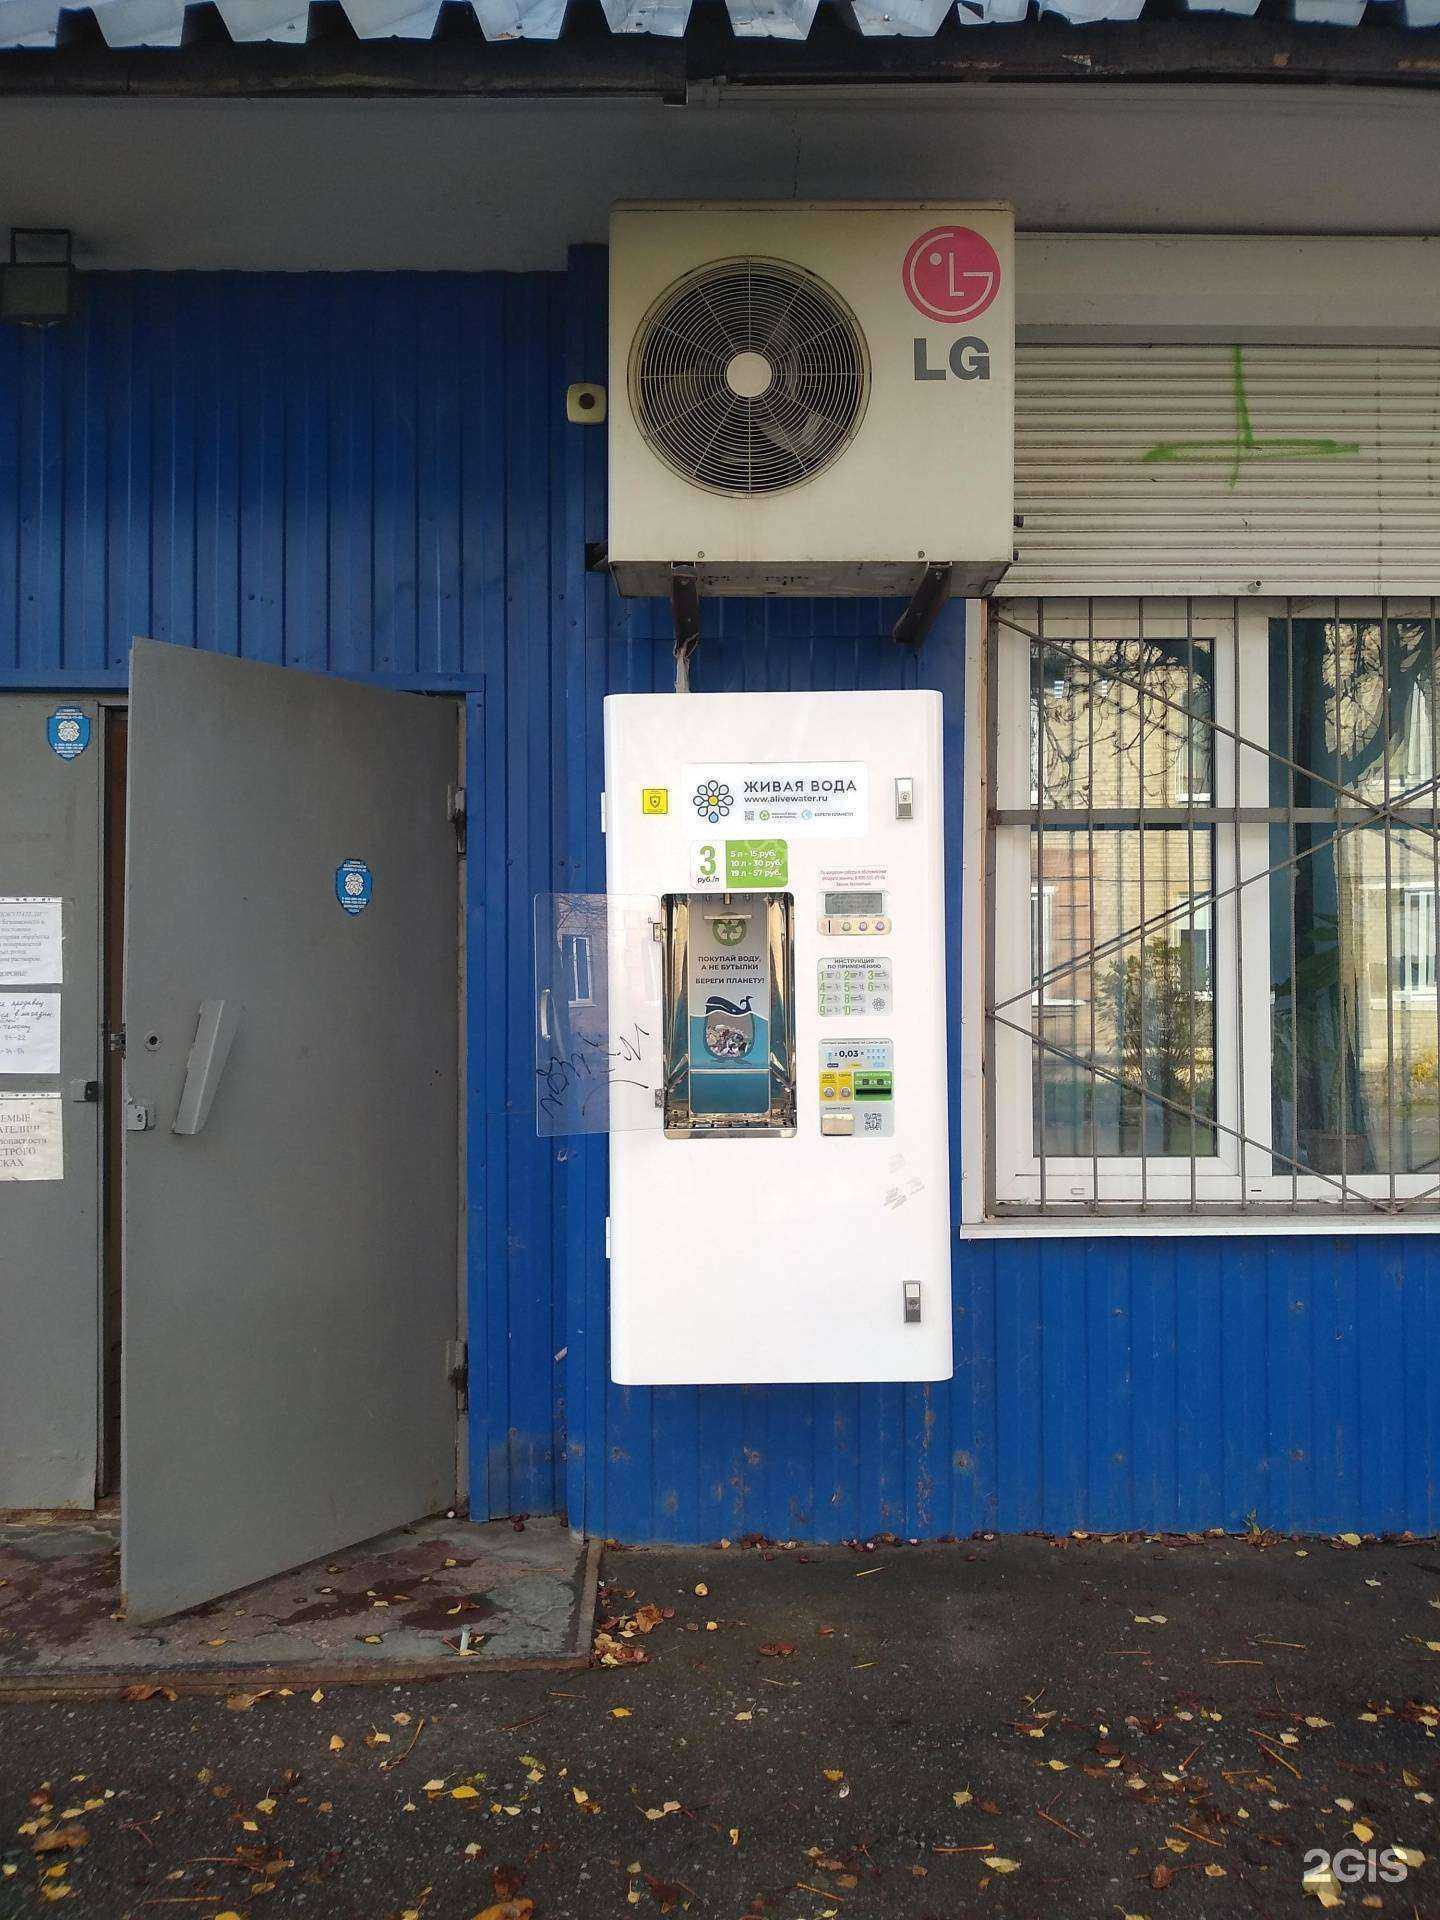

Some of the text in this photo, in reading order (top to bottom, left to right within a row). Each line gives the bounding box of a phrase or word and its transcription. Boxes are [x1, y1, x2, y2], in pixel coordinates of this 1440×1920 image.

[913, 336, 991, 381] LG
[744, 780, 857, 793] ЖИВАЯ ВОДА
[744, 794, 828, 804] www.alivewater.ru
[700, 845, 716, 875] 3
[753, 859, 764, 867] 30
[753, 869, 763, 877] 57
[698, 954, 737, 962] ПОКУПАЙ
[839, 1050, 859, 1058] 0,03
